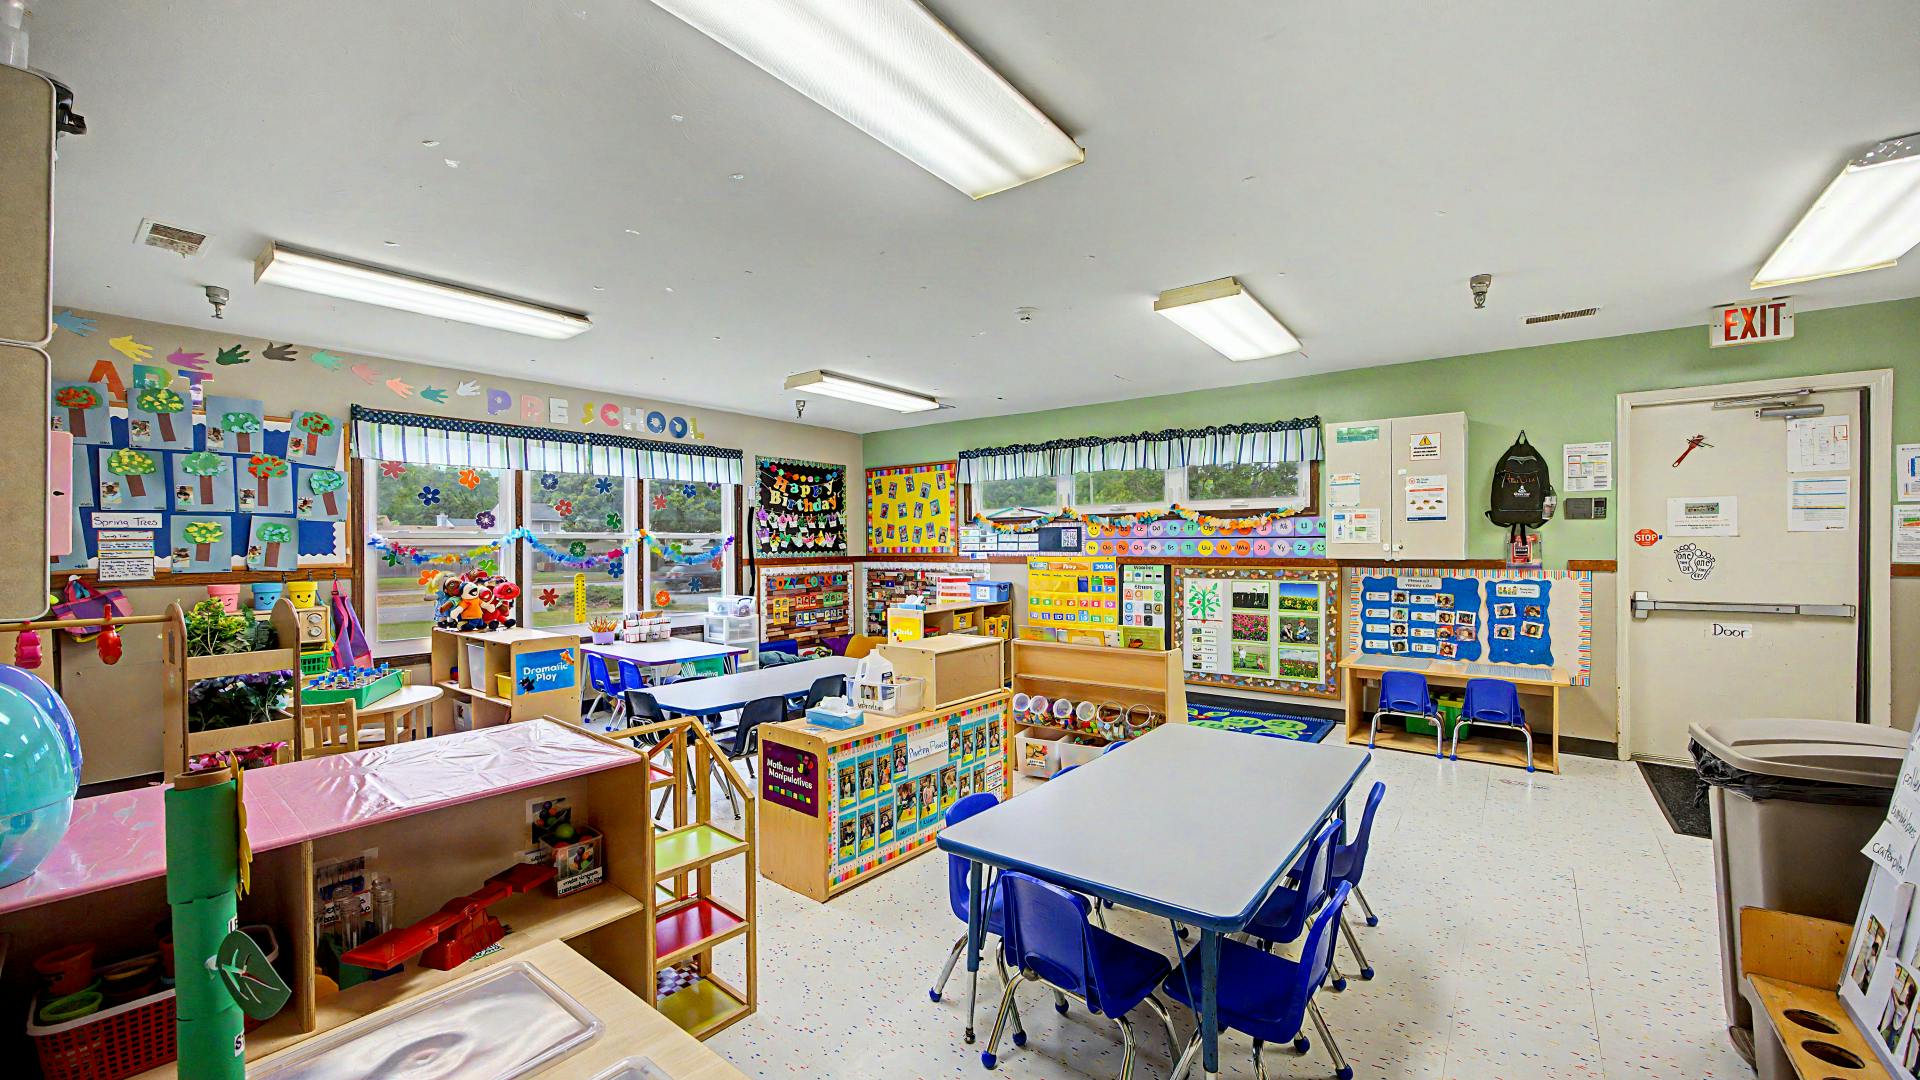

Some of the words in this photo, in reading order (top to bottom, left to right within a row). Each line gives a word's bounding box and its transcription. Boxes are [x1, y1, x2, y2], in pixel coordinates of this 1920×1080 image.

[1725, 303, 1786, 341] EXIT
[88, 360, 214, 407] ART
[774, 476, 834, 498] Happy
[769, 488, 837, 512] Birthday
[93, 516, 129, 528] Spring
[132, 516, 158, 526] Trees
[1635, 534, 1657, 542] STOP
[769, 576, 798, 590] COZY
[804, 574, 843, 587] CORNER
[1712, 623, 1745, 638] Door
[523, 662, 569, 675] Dramatic
[536, 673, 557, 682] Play
[766, 758, 783, 770] Math
[783, 766, 794, 774] and
[768, 768, 813, 789] Manipulatives
